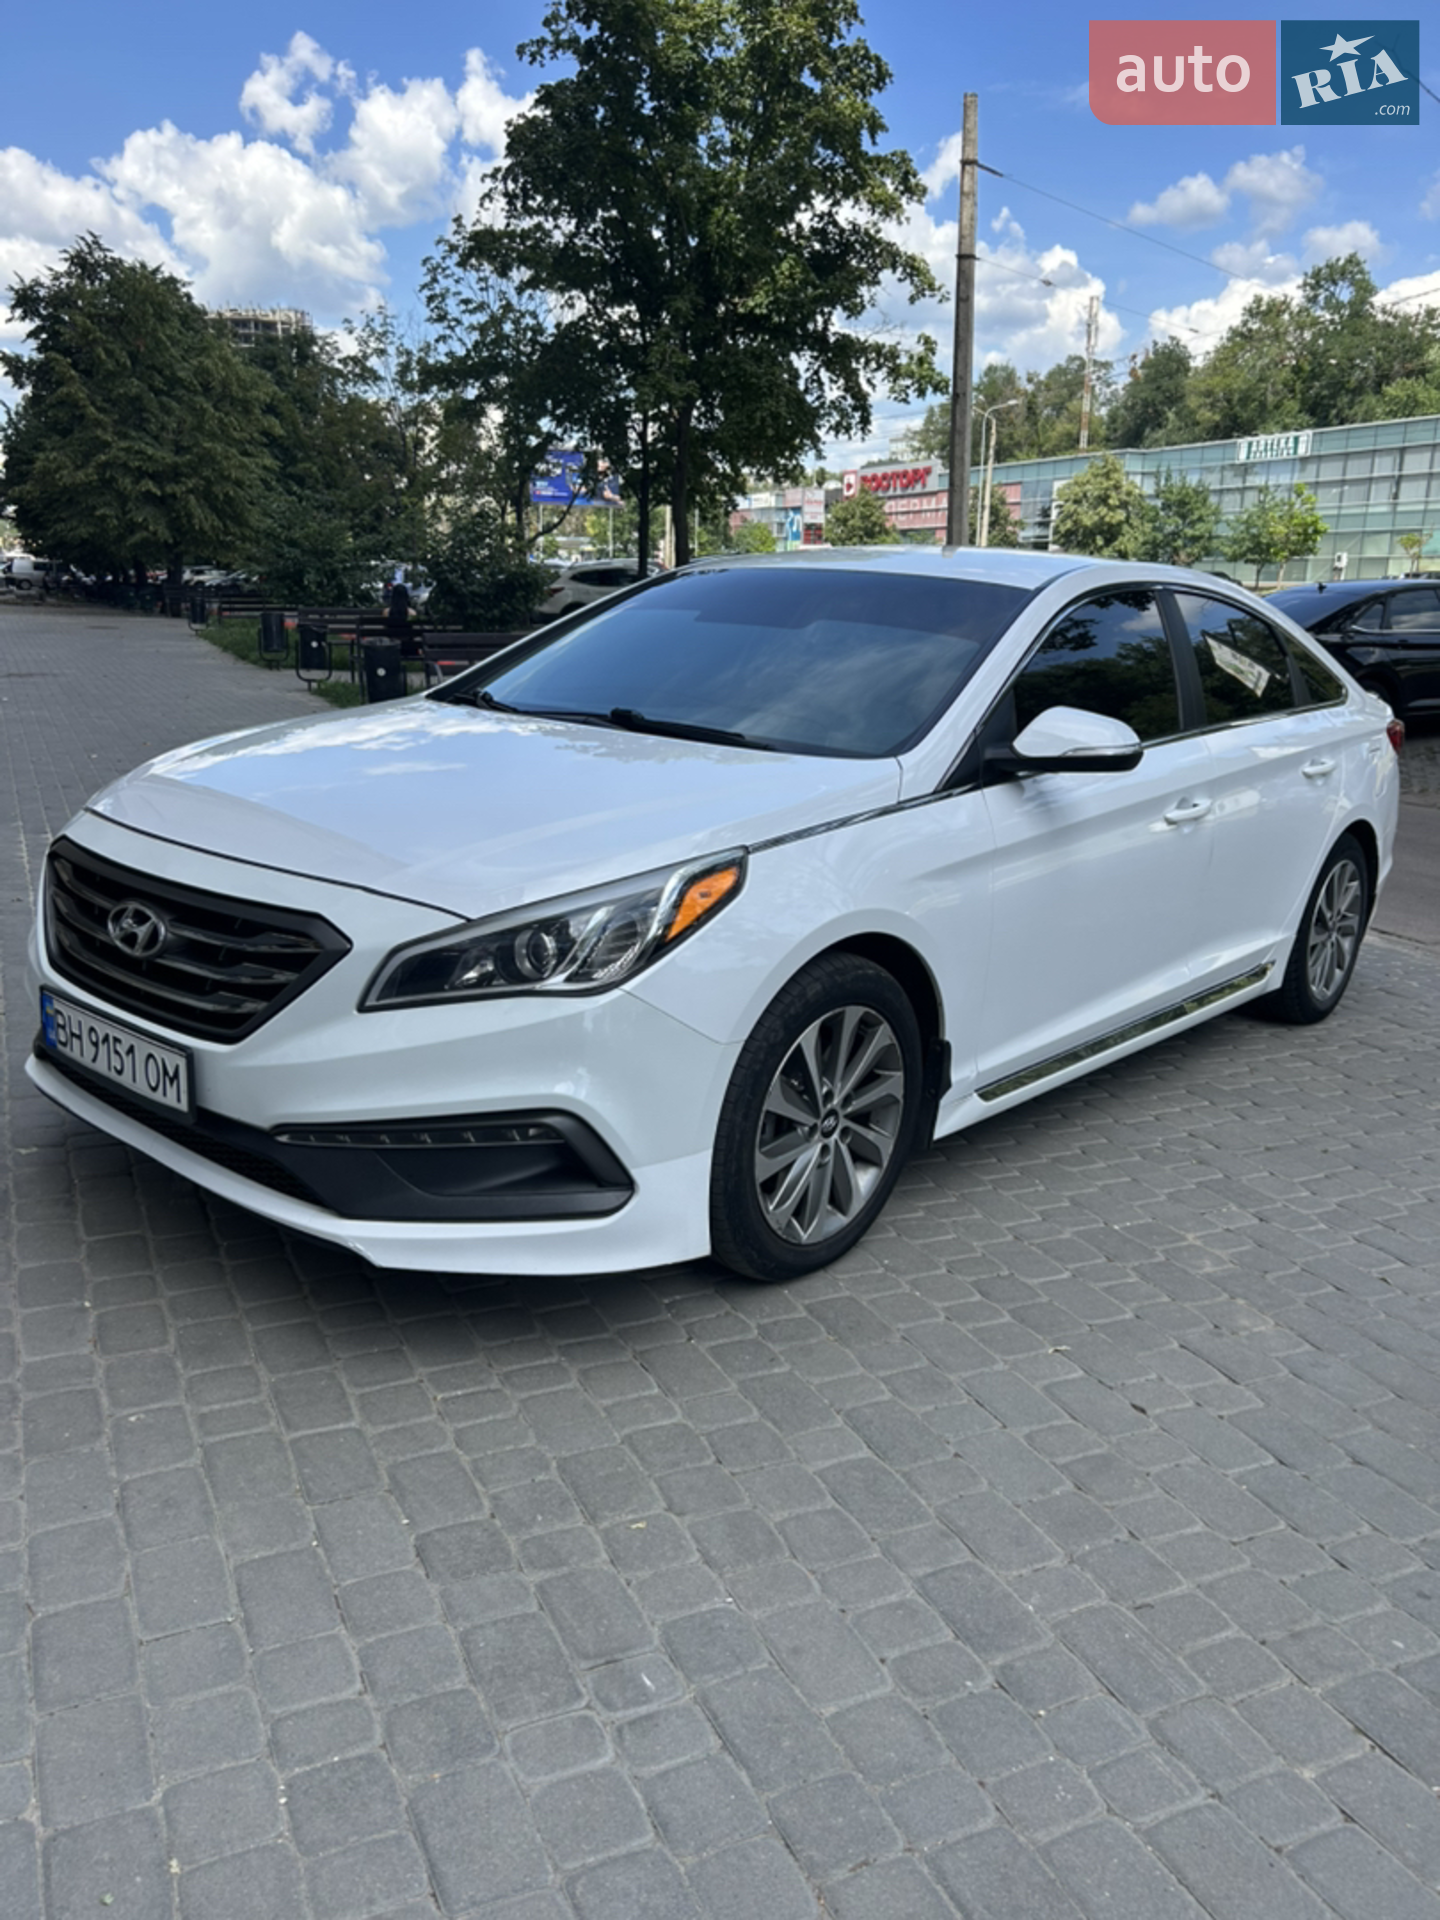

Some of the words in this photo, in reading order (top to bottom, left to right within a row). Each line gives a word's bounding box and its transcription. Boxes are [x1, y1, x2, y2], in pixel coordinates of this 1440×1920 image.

[54, 1008, 84, 1058] BH
[87, 1025, 137, 1084] 9151
[145, 1052, 182, 1104] OM
